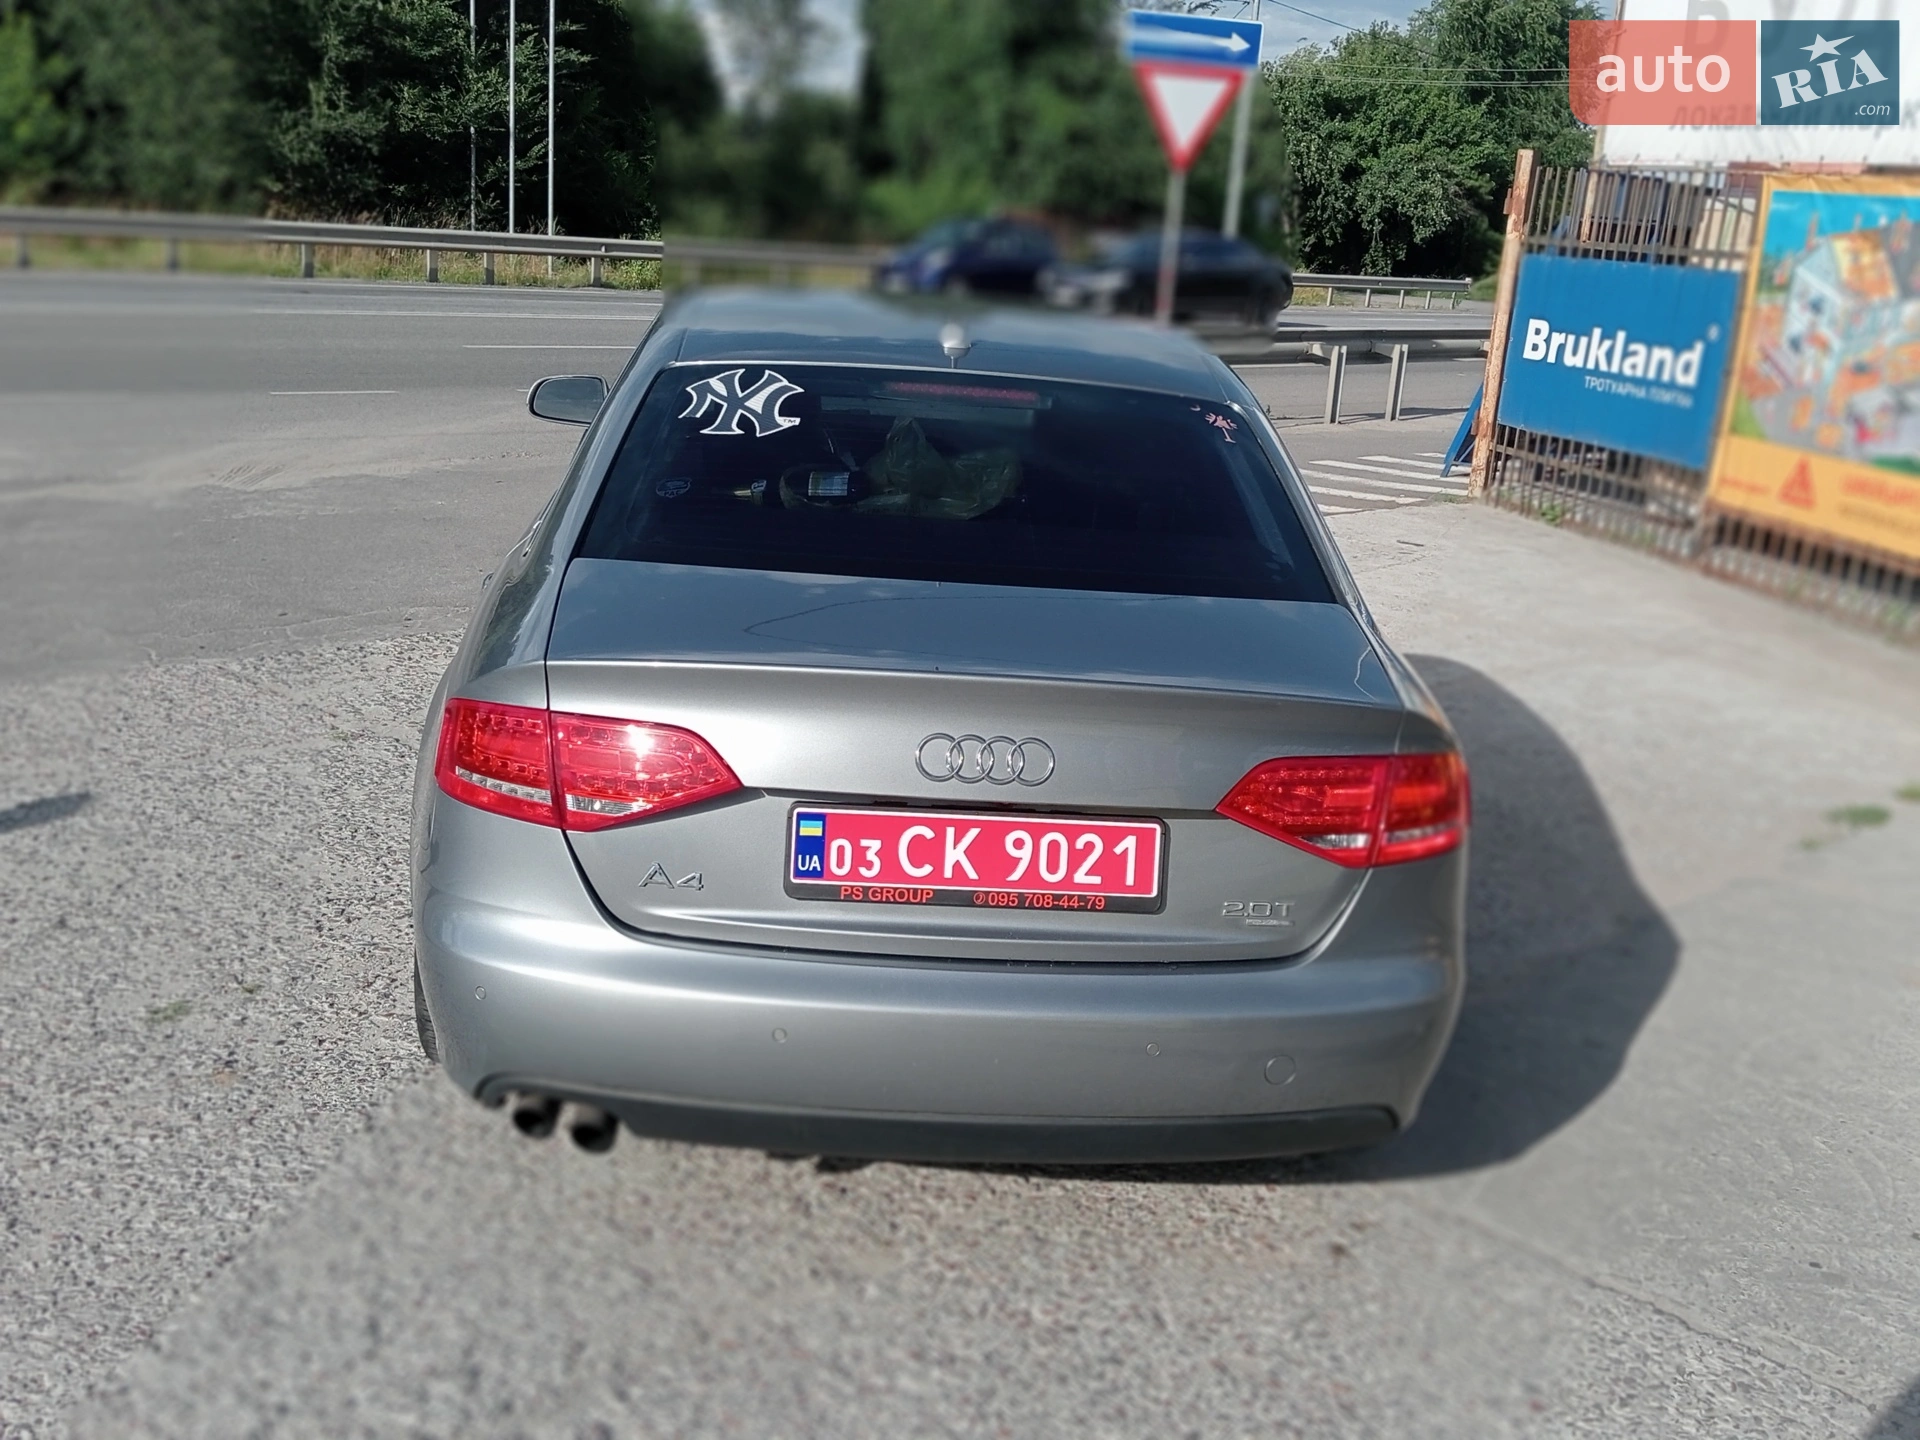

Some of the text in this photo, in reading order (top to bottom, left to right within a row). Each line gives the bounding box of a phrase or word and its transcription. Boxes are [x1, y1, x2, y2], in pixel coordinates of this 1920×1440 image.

[1522, 317, 1704, 388] Brukland
[797, 854, 822, 872] UA
[828, 824, 1138, 887] 03 CK 9021
[638, 861, 705, 892] A4
[840, 885, 934, 904] PS GROUP
[988, 891, 1106, 910] 095 708-44-79
